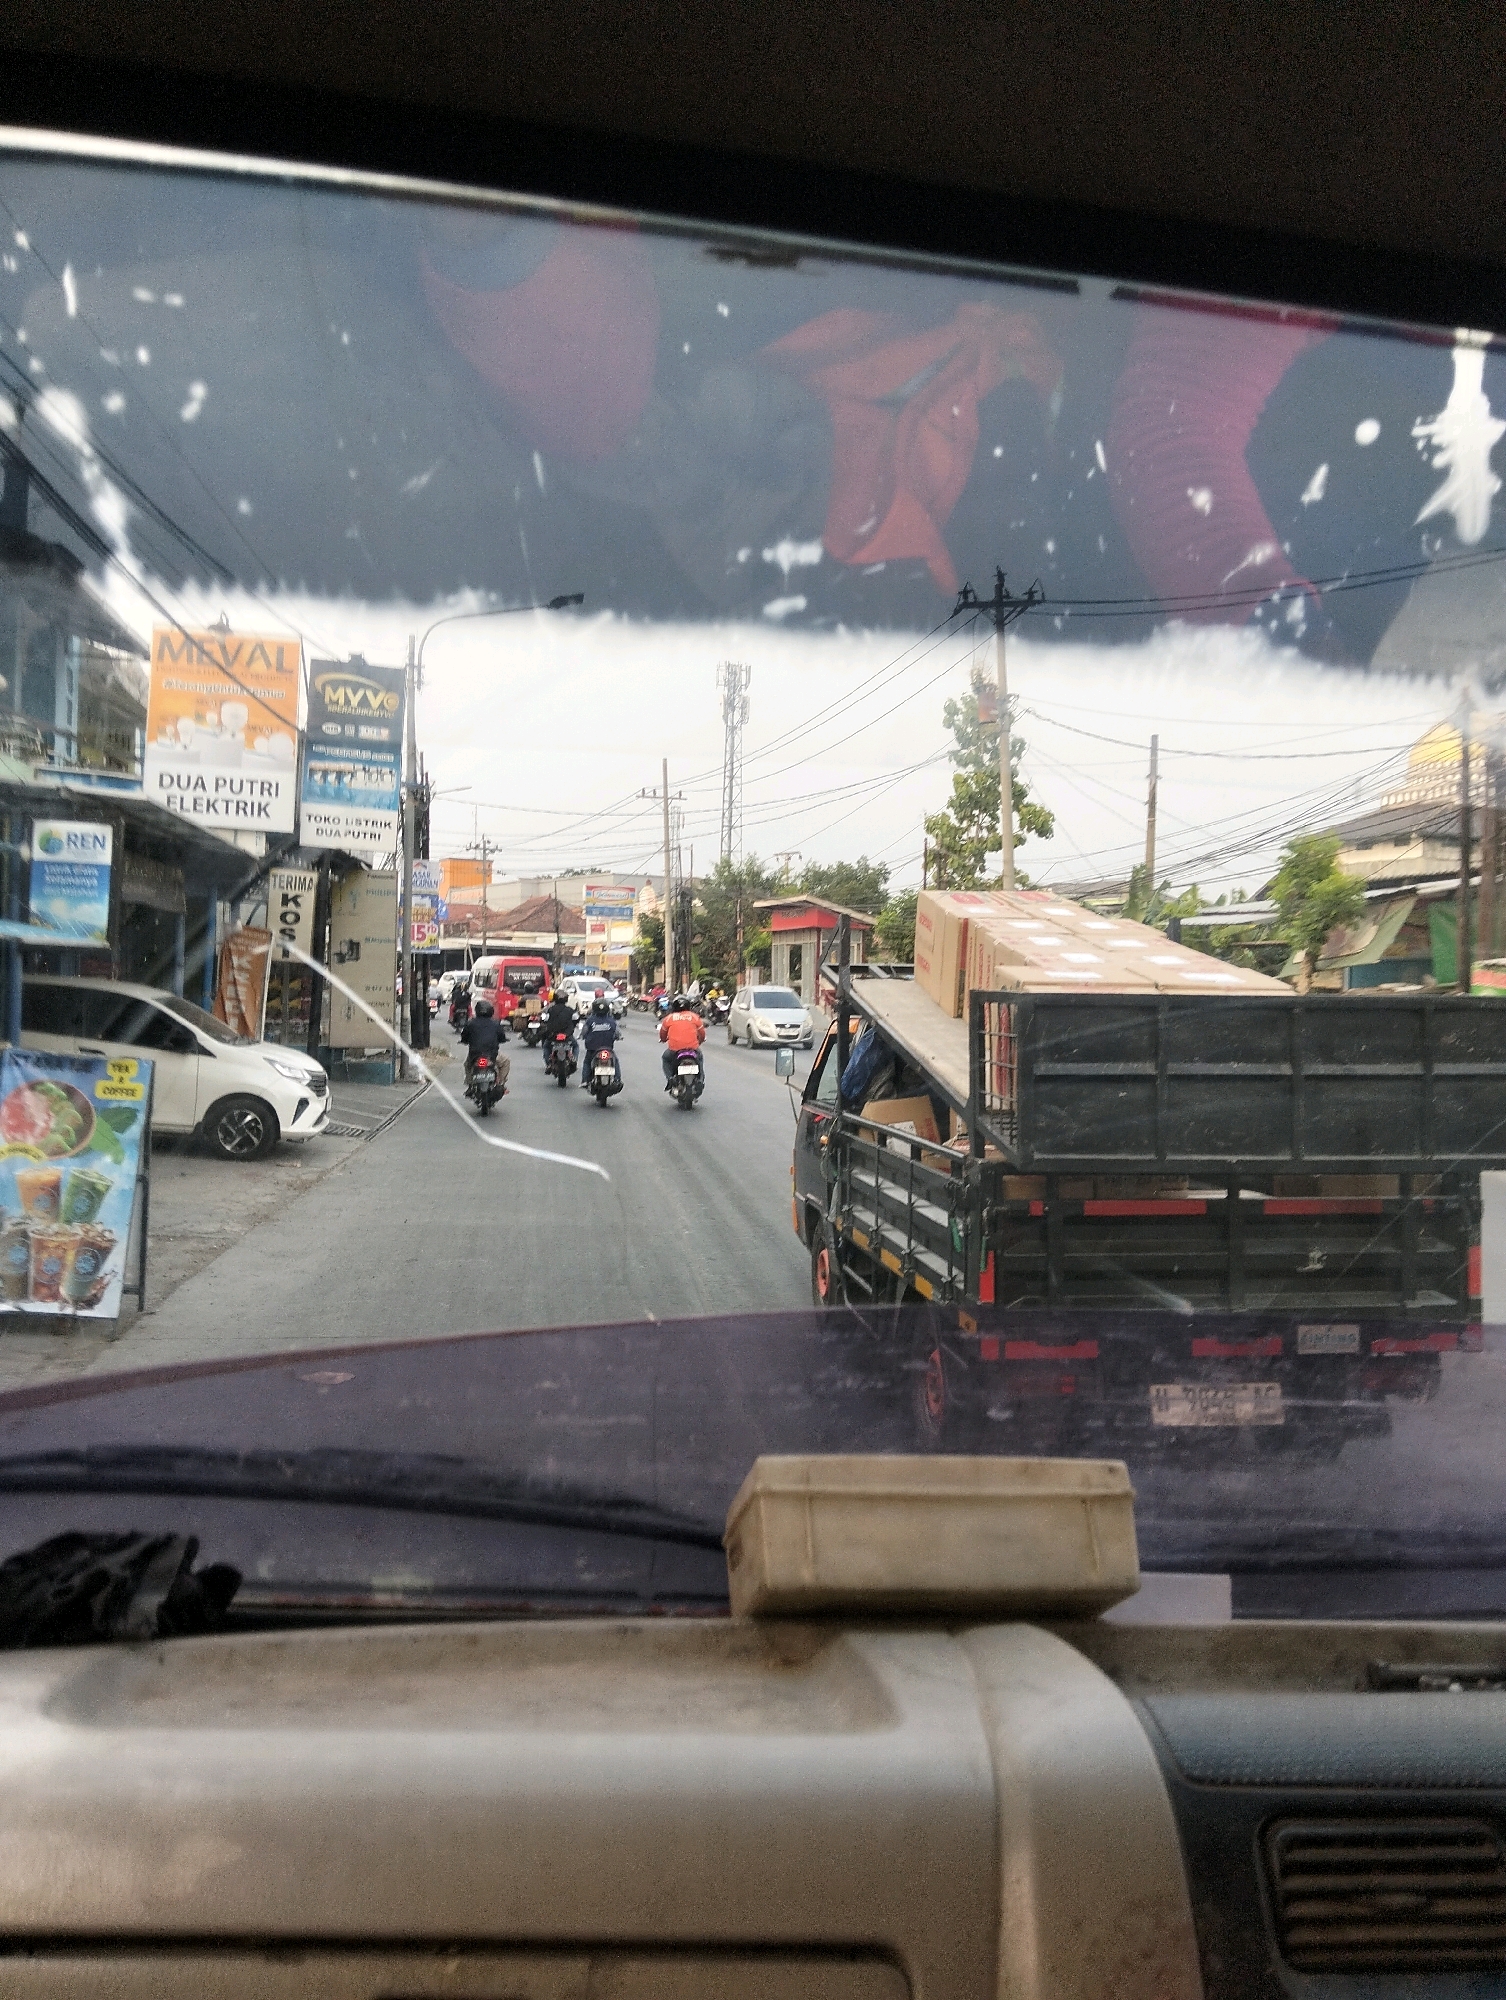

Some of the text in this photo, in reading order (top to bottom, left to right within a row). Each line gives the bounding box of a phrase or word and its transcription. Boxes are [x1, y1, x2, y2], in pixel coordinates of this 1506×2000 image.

[156, 634, 294, 675] MEVAL
[158, 772, 280, 799] DUA PUTRI
[166, 795, 271, 819] ELEKTRIK
[305, 812, 393, 830] TOKO LISTRIK
[66, 832, 106, 850] REN
[315, 827, 382, 842] DUA PUTRI
[271, 874, 315, 892] TERIMA
[111, 1062, 131, 1074] TEA
[102, 1087, 137, 1098] COFFEE
